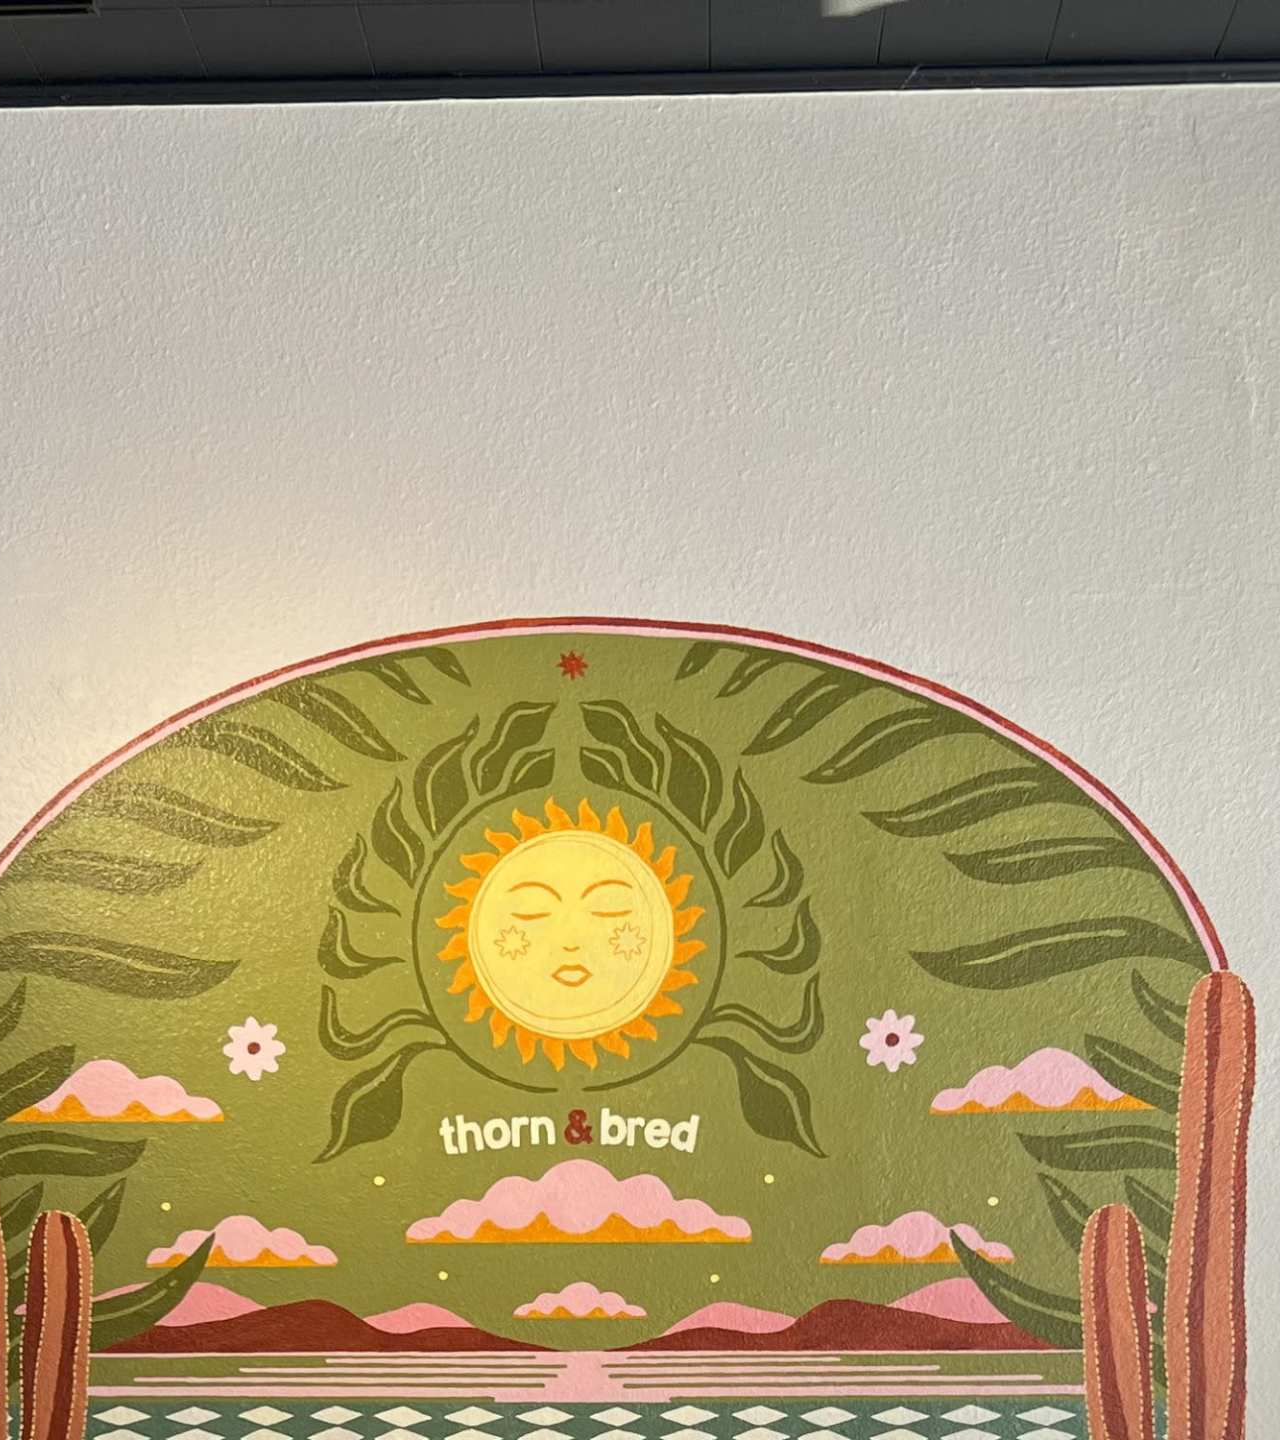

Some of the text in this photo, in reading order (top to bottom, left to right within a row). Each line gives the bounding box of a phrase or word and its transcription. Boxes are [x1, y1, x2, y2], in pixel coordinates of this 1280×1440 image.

[439, 1107, 700, 1155] thorn & bred
